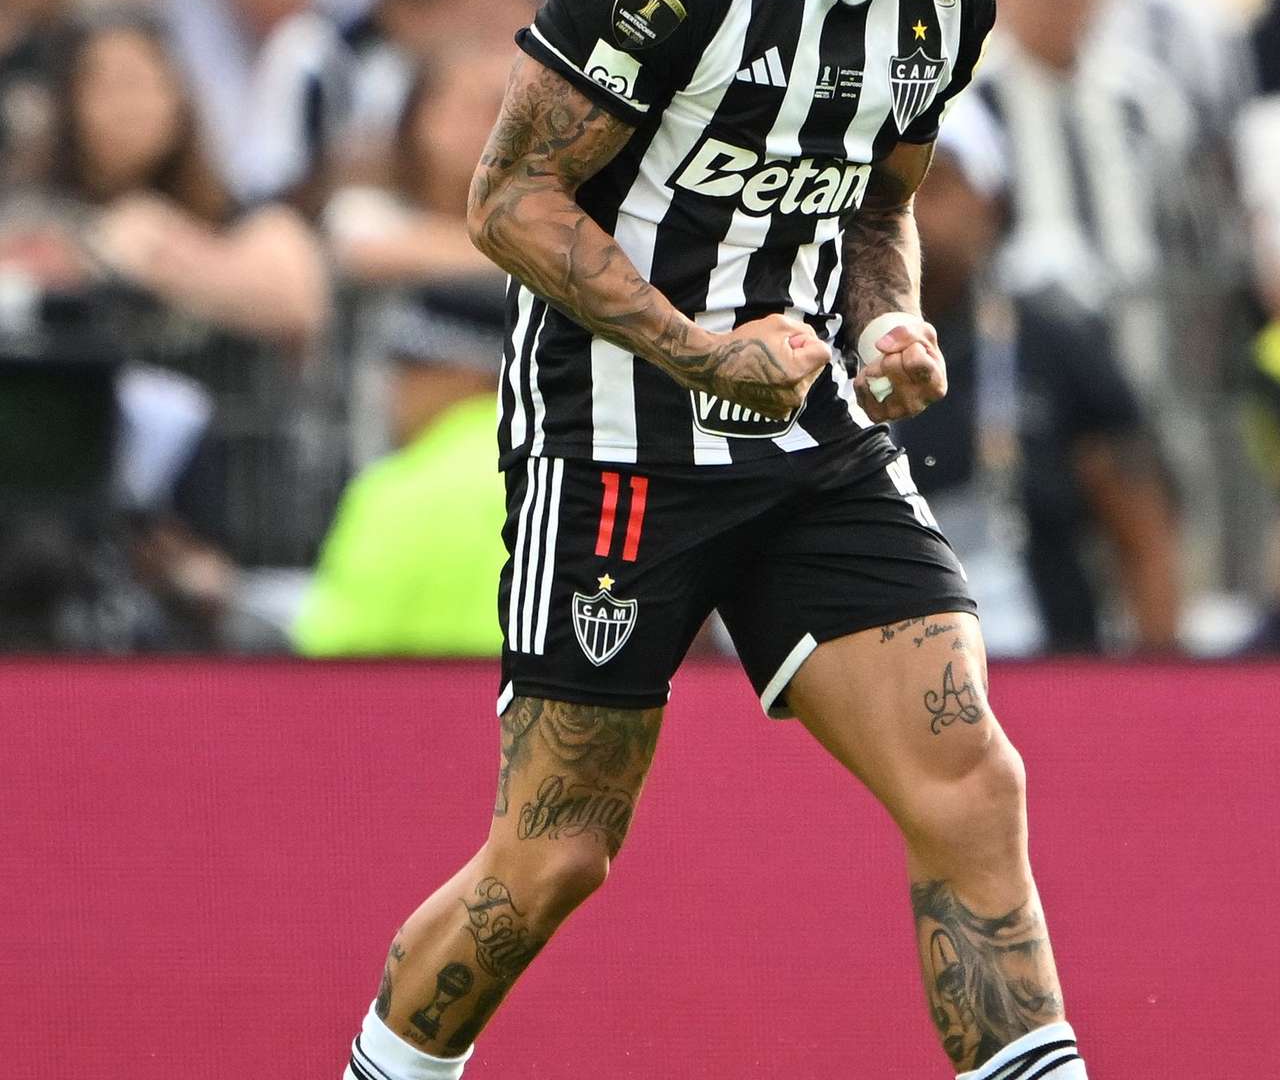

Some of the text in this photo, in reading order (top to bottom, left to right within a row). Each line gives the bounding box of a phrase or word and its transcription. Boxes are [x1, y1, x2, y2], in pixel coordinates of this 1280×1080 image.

[896, 64, 937, 79] CAM
[675, 138, 872, 215] Betan
[594, 471, 649, 563] 11
[583, 604, 626, 621] CAM
